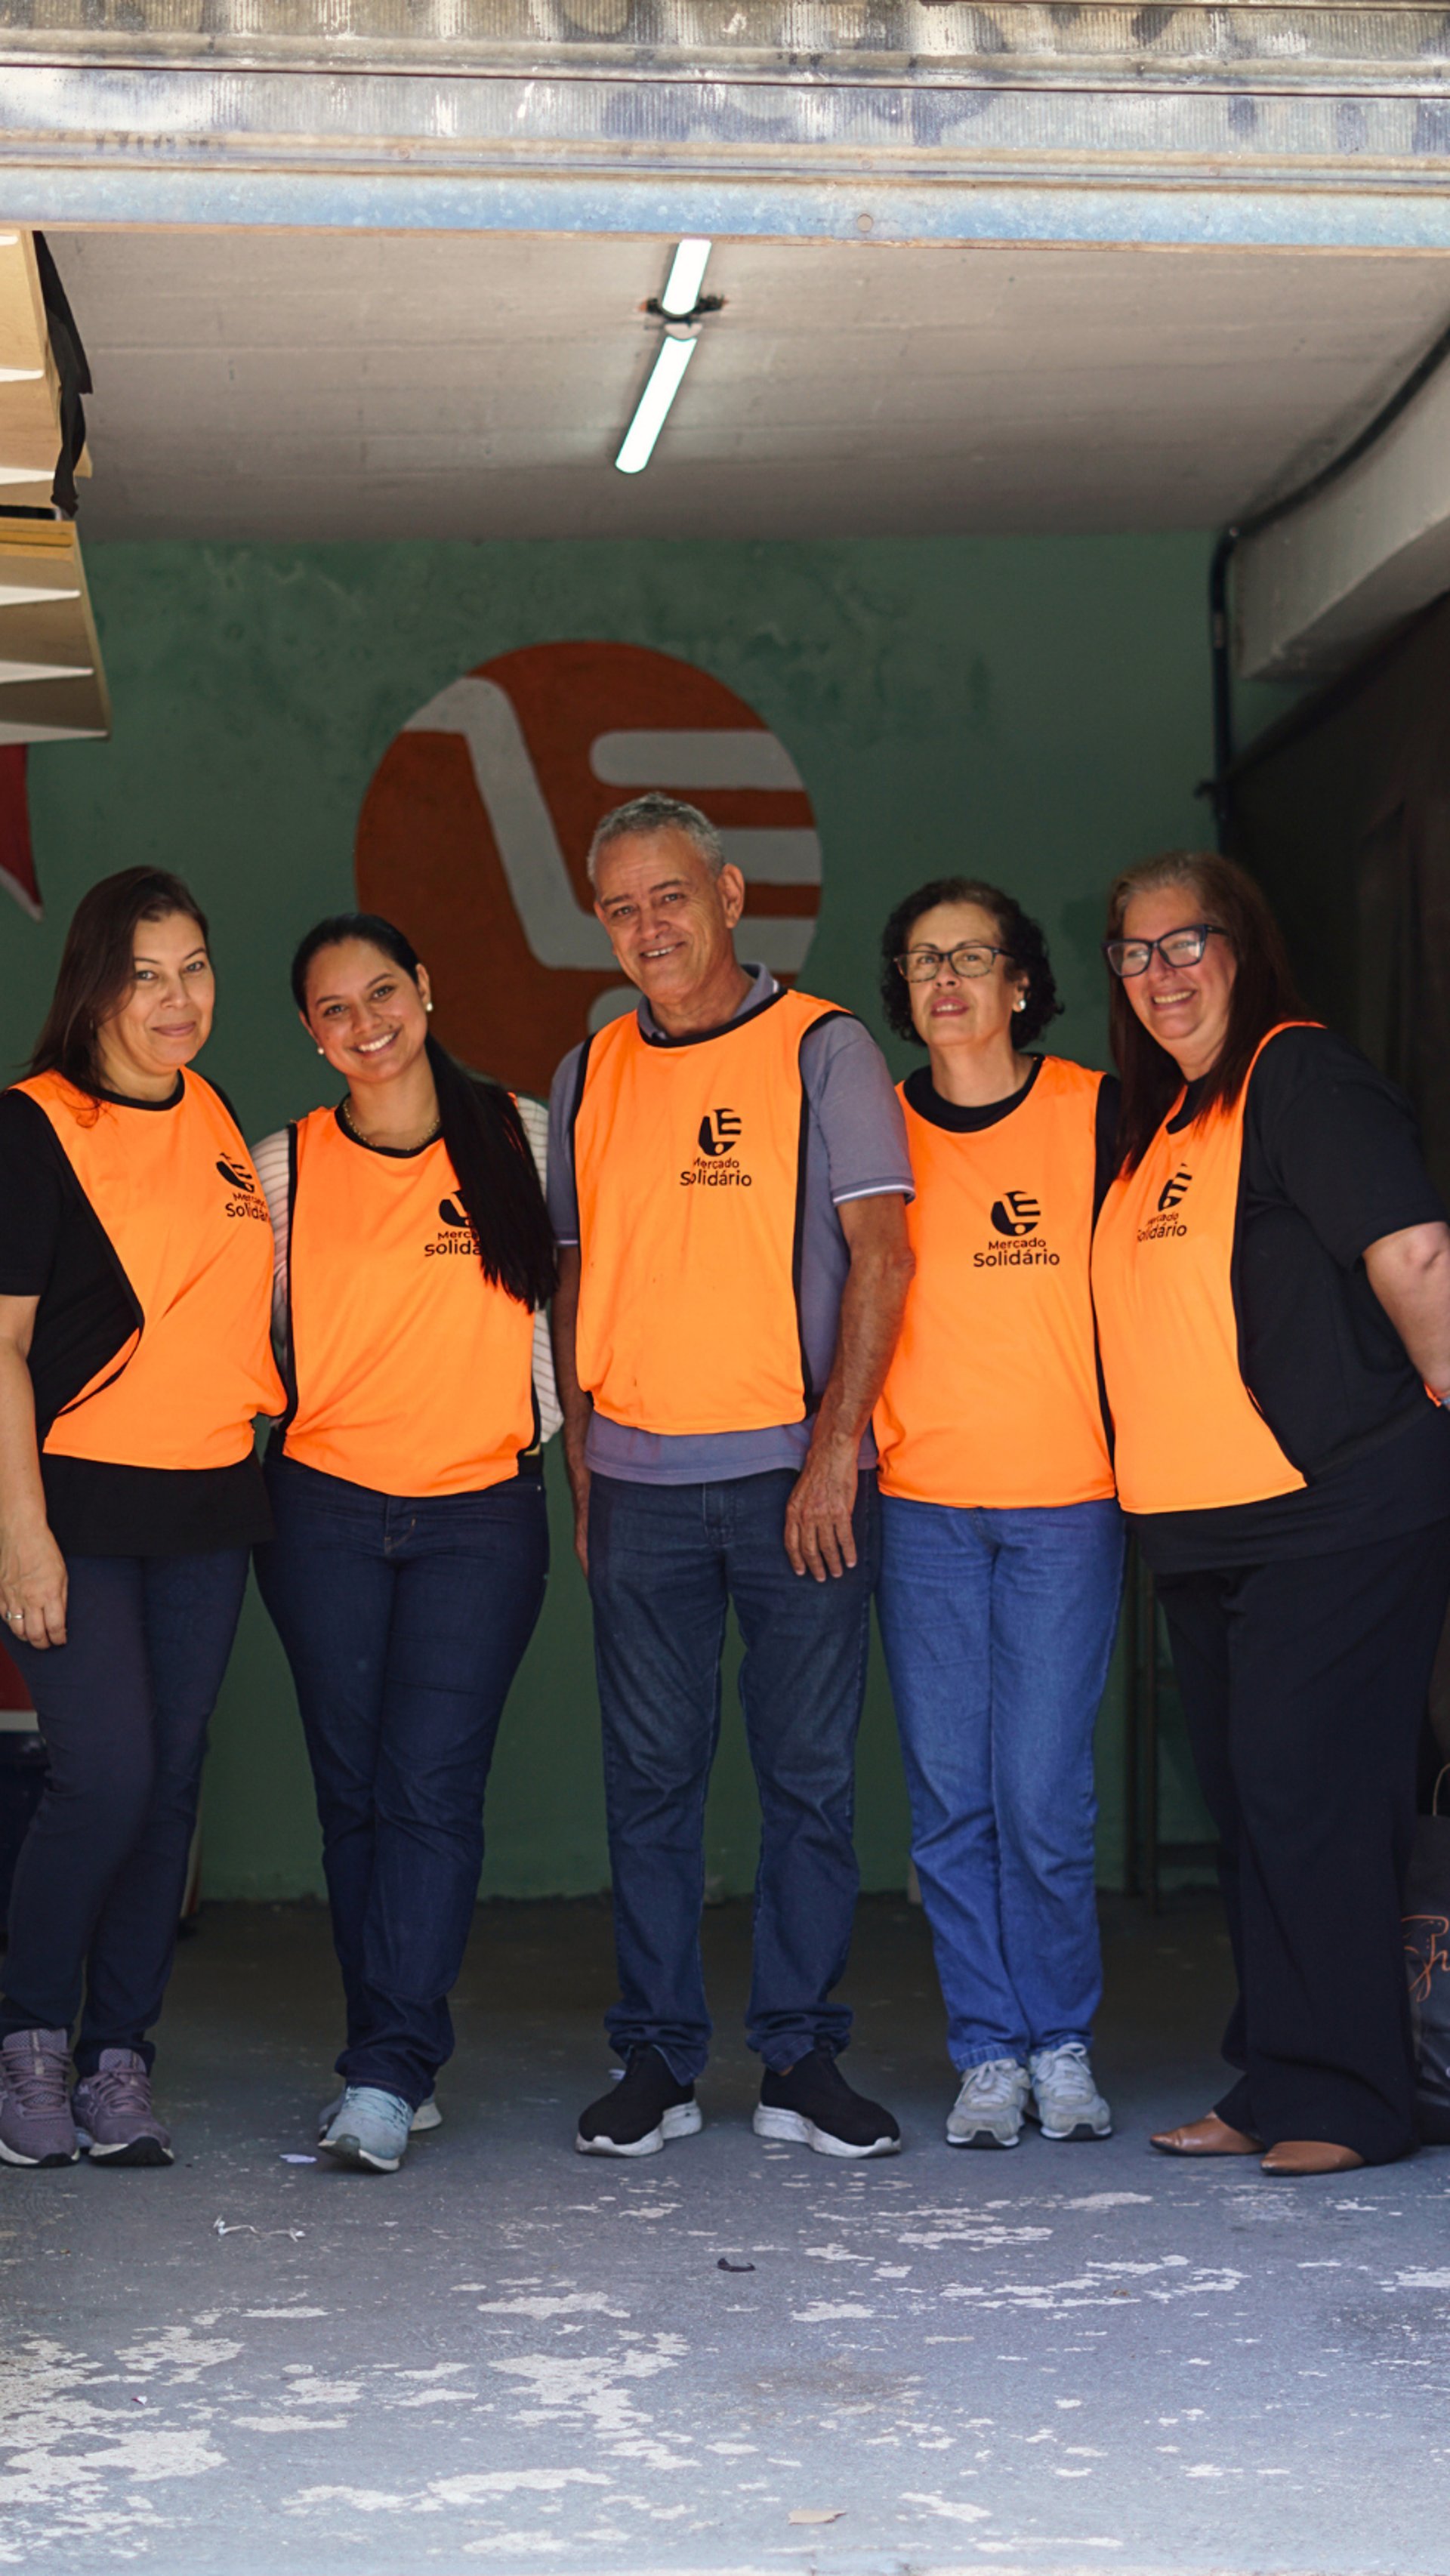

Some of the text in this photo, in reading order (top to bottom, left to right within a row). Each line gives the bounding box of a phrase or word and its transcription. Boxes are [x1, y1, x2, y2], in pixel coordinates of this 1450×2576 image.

[680, 1169, 752, 1186] Solidário
[988, 1237, 1046, 1251] Mercado
[973, 1248, 1060, 1267] Solidário
